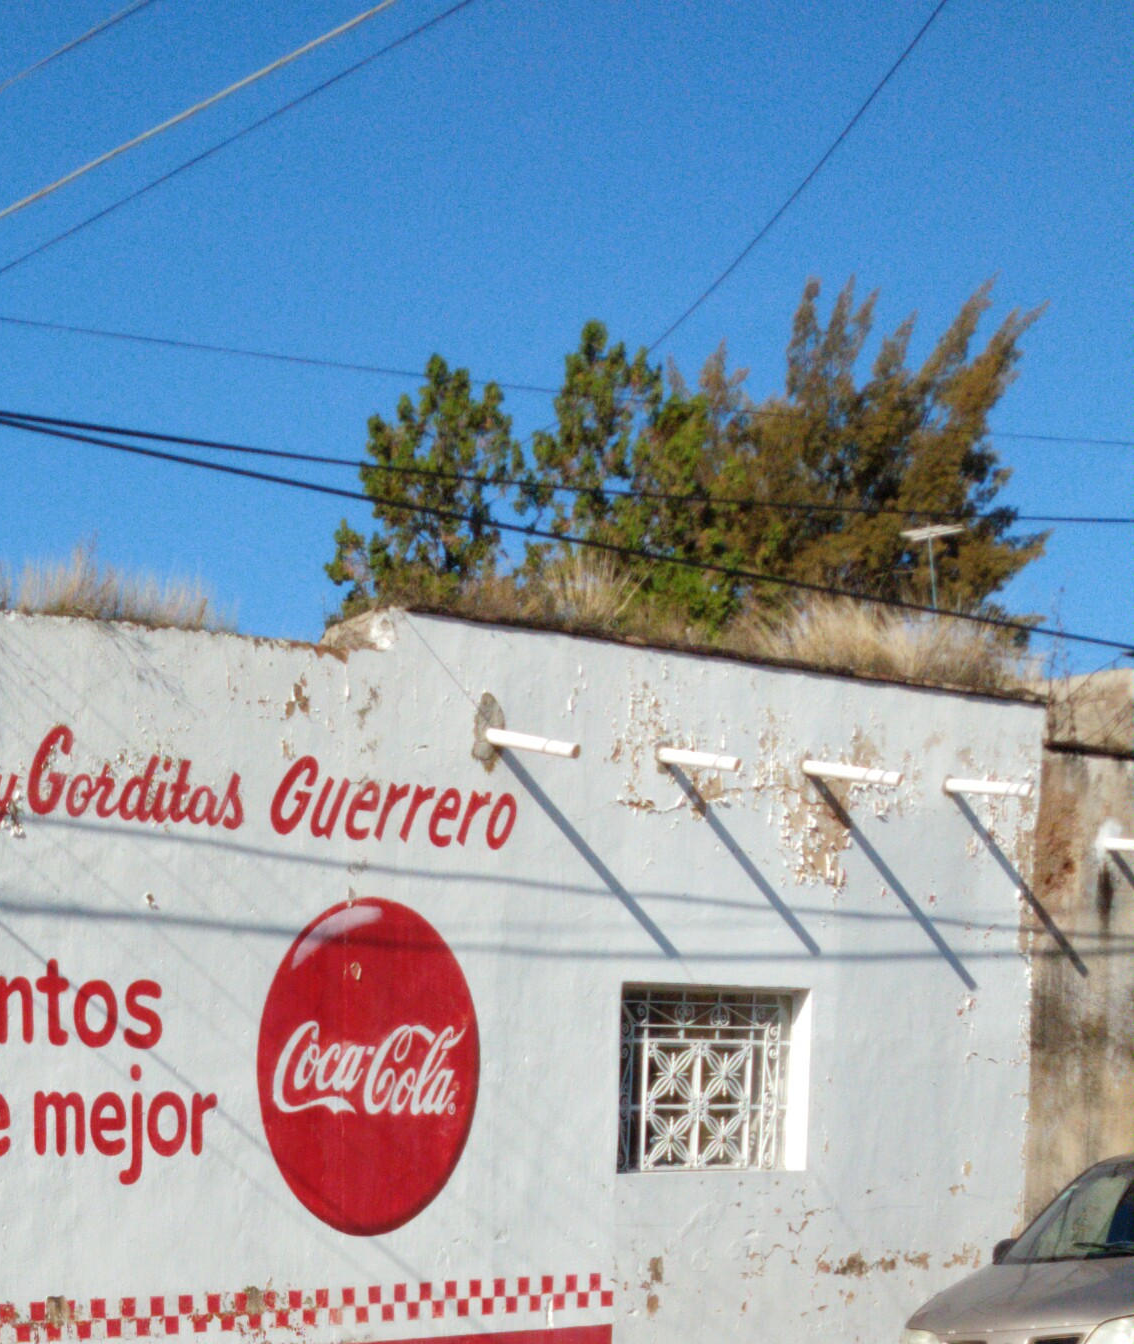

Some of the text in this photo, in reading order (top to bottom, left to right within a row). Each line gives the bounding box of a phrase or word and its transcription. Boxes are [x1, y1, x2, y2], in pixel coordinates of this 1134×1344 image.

[28, 724, 244, 831] Gorditas
[270, 755, 517, 850] Guerrero
[33, 1064, 218, 1186] mejor
[272, 1020, 466, 1116] Coca-Cola
